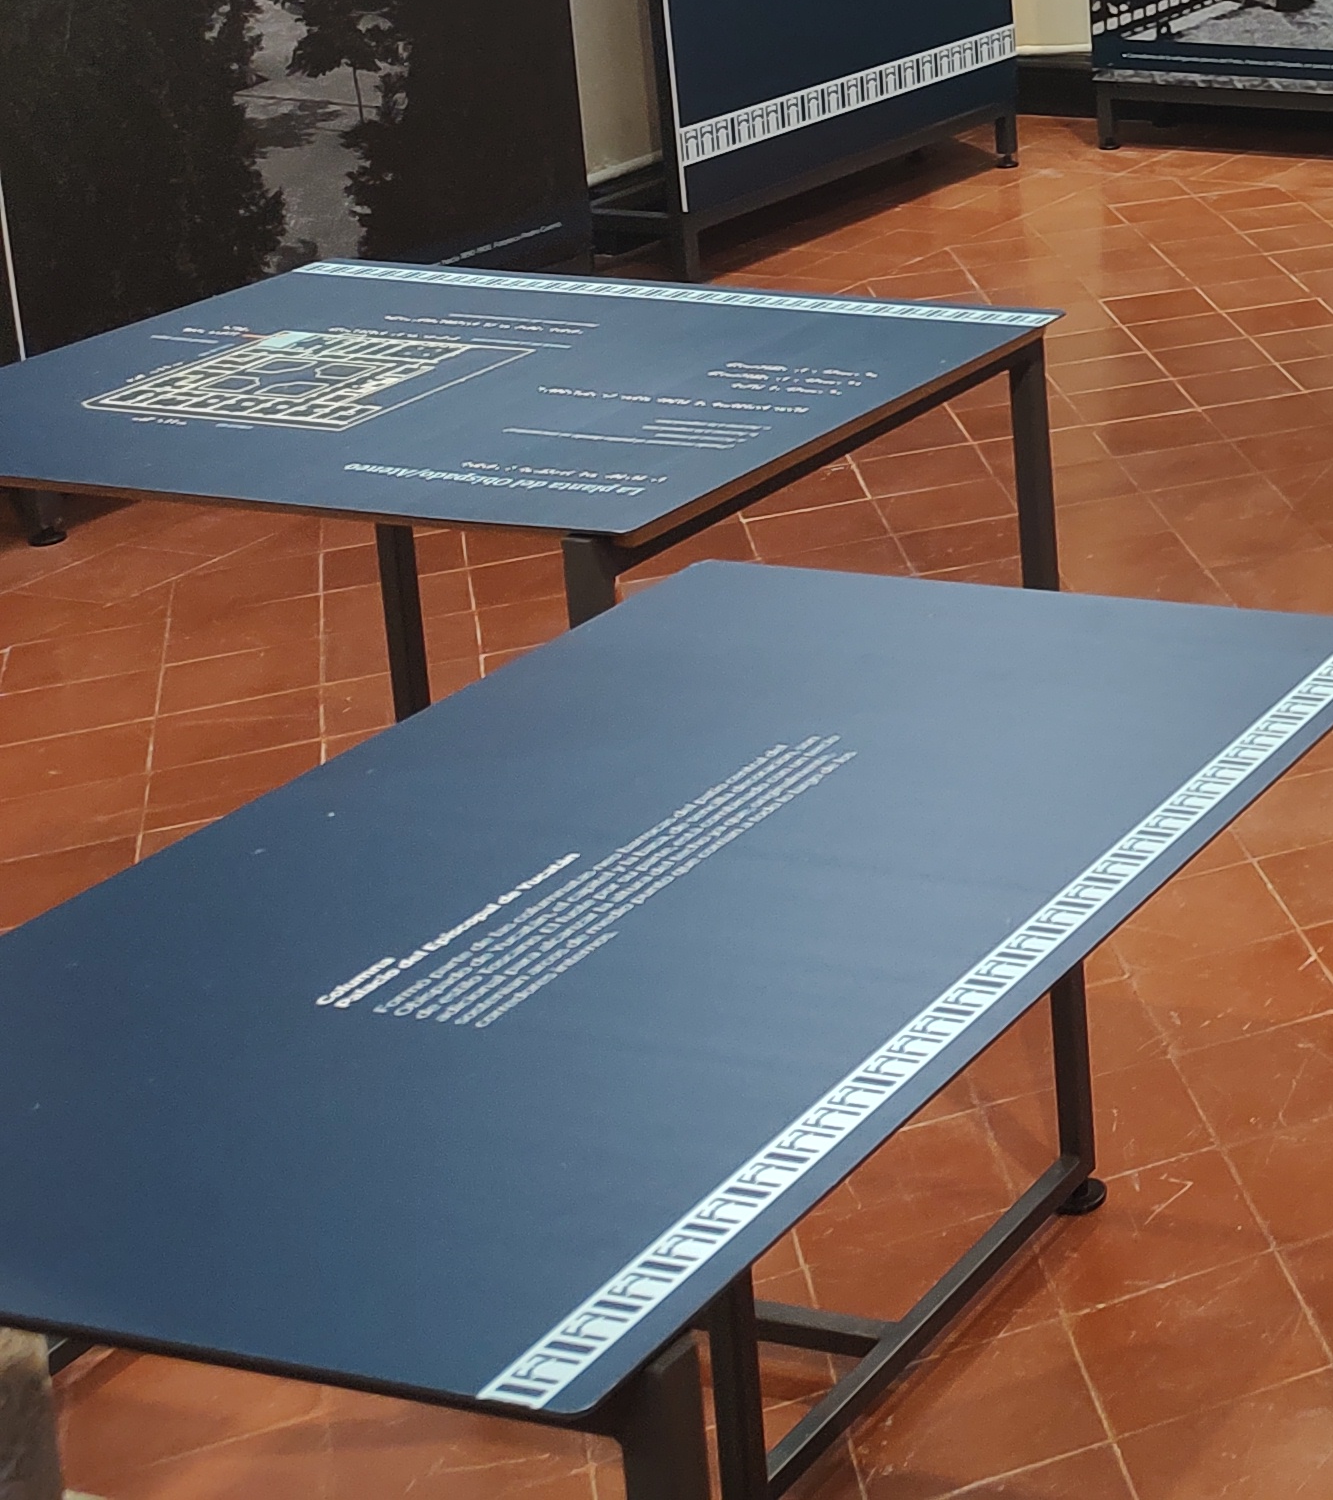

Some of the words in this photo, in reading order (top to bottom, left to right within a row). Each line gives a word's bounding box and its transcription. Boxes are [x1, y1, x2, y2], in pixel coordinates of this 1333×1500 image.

[316, 957, 396, 1005] Columna
[334, 968, 400, 1008] Palacio
[398, 950, 429, 969] del
[422, 903, 501, 951] Episcopal
[498, 891, 522, 904] de
[515, 853, 580, 890] Yucatán
